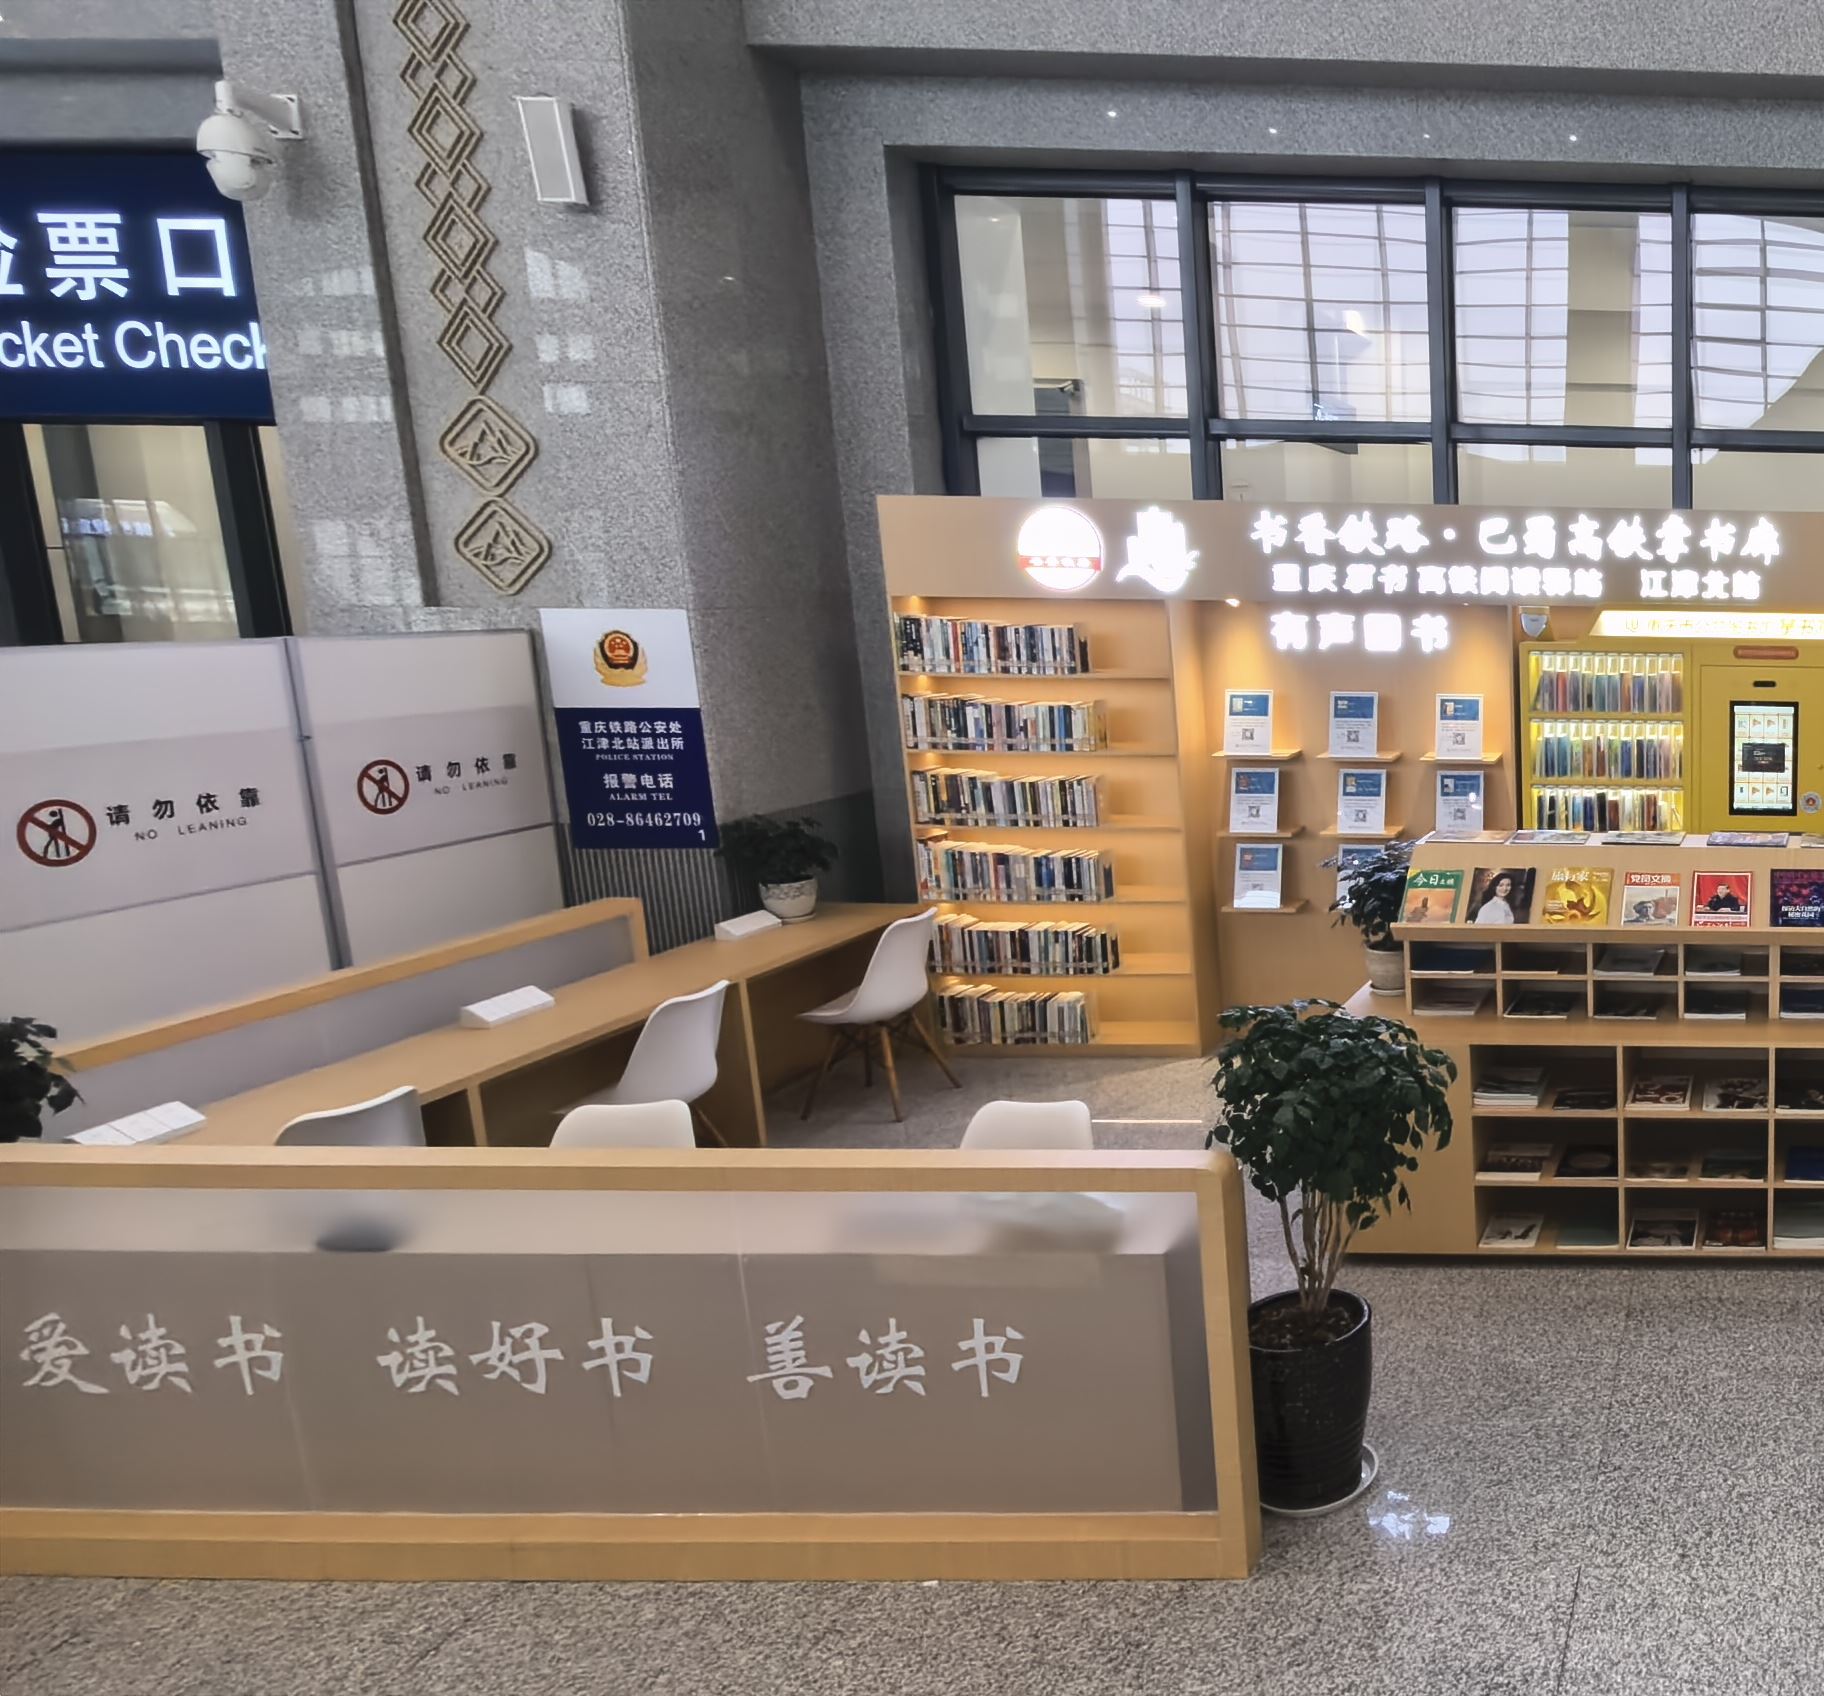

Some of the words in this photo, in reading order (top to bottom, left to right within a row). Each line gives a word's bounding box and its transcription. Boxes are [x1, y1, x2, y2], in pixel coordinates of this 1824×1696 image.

[0, 212, 237, 301] 票口
[579, 721, 682, 733] 重庆铁路公安处
[582, 738, 684, 750] 江津北站派出所
[595, 753, 630, 761] POLICE
[632, 753, 674, 761] STATION
[415, 752, 518, 783] 请勿依靠
[434, 786, 452, 796] NO
[462, 776, 509, 794] LEANING
[603, 774, 674, 788] 报警电话
[609, 793, 647, 801] ALARM
[651, 793, 673, 801] TEL
[105, 787, 262, 826] 请勿依靠
[587, 812, 701, 827] 028-86462709
[134, 829, 158, 841] NO
[177, 816, 248, 837] LEANING
[698, 829, 706, 841] 1
[19, 1311, 286, 1396] 爱读书
[376, 1314, 655, 1398] 读好书
[746, 1315, 1025, 1402] 善读书
